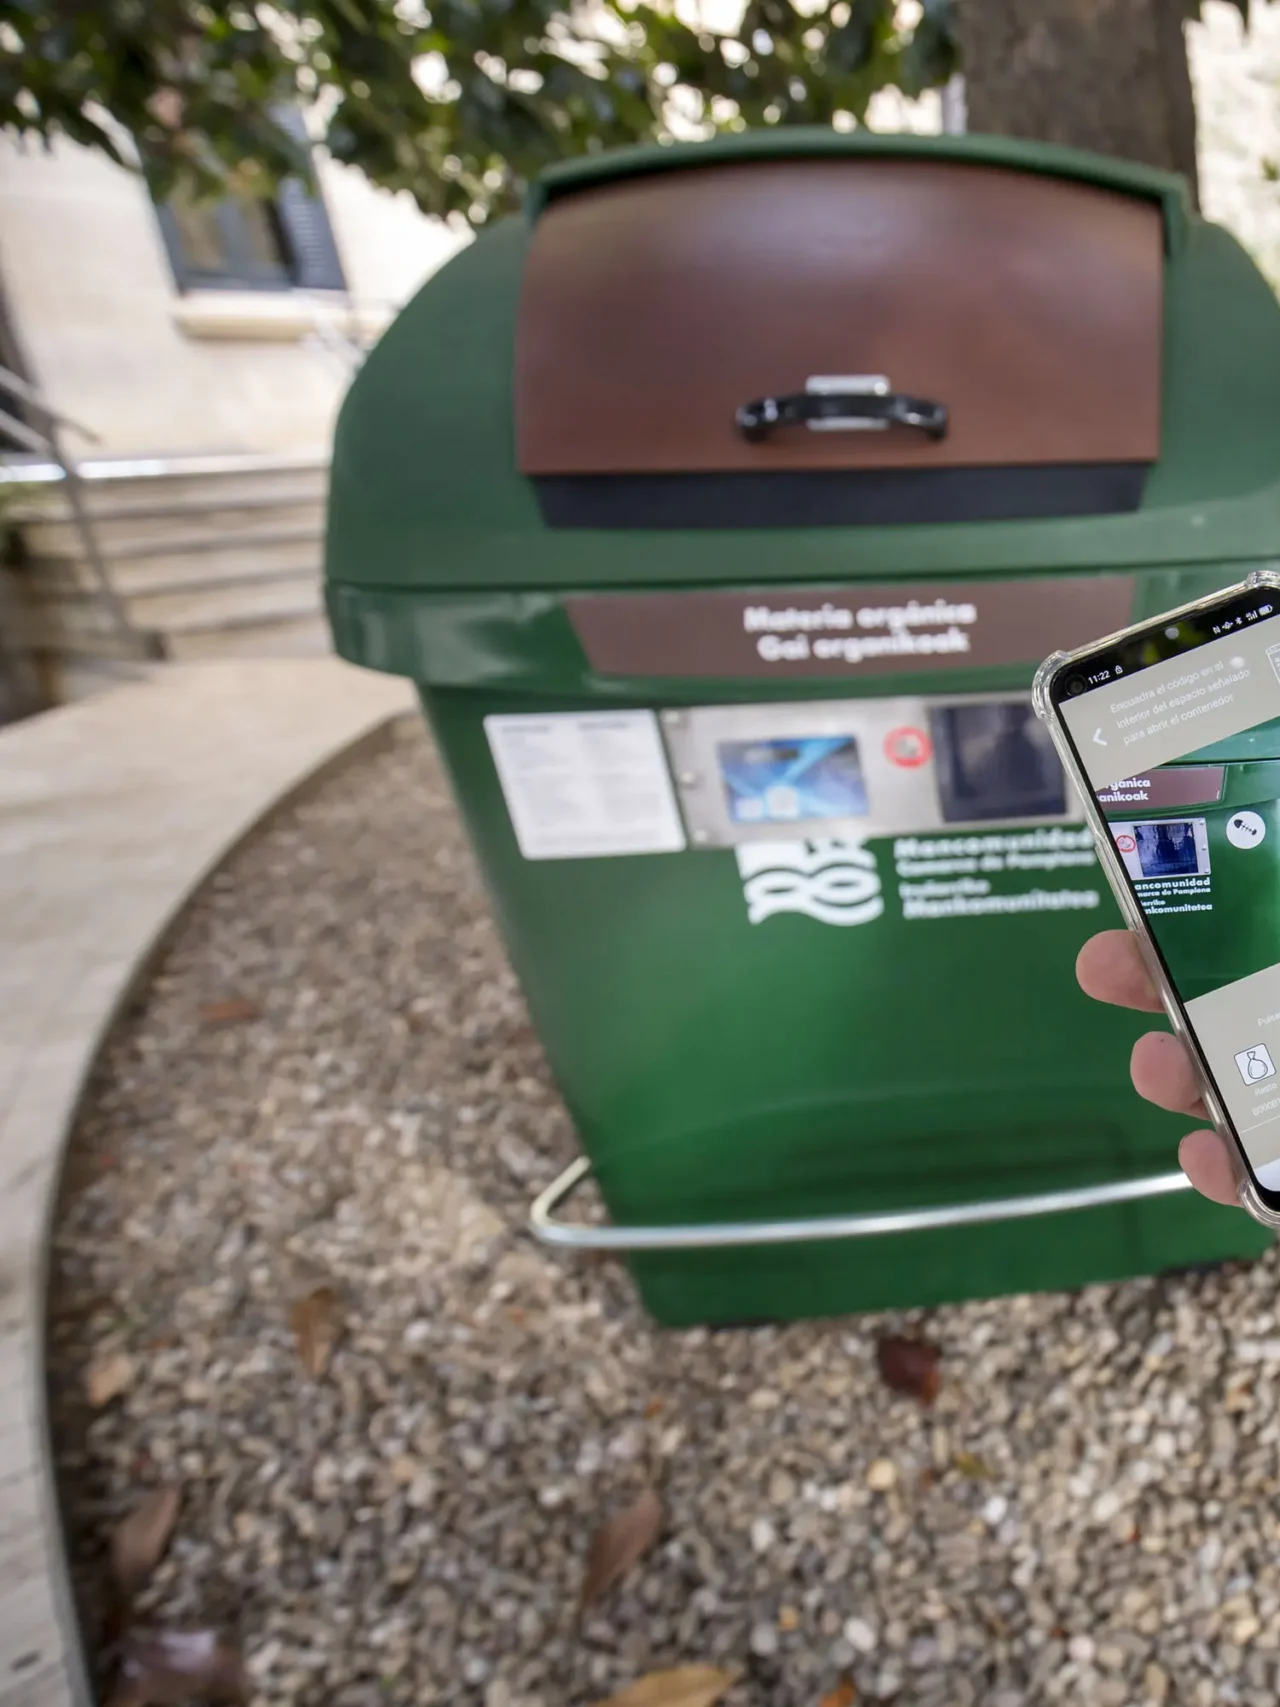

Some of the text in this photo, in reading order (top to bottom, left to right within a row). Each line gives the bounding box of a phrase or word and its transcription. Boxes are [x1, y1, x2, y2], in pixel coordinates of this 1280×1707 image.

[744, 603, 853, 632] Materia
[1088, 670, 1110, 684] 11:22
[1110, 661, 1224, 713] Encuadra el código en el
[1152, 701, 1168, 714] del
[1169, 688, 1206, 708] espacio
[1208, 668, 1250, 692] señalado
[1123, 693, 1234, 746] para abrir el contenedor
[1097, 790, 1149, 802] anikoak
[1135, 877, 1210, 890] ancomunidad
[1145, 904, 1212, 914] nkomunitatea
[1255, 1082, 1277, 1096] Resto
